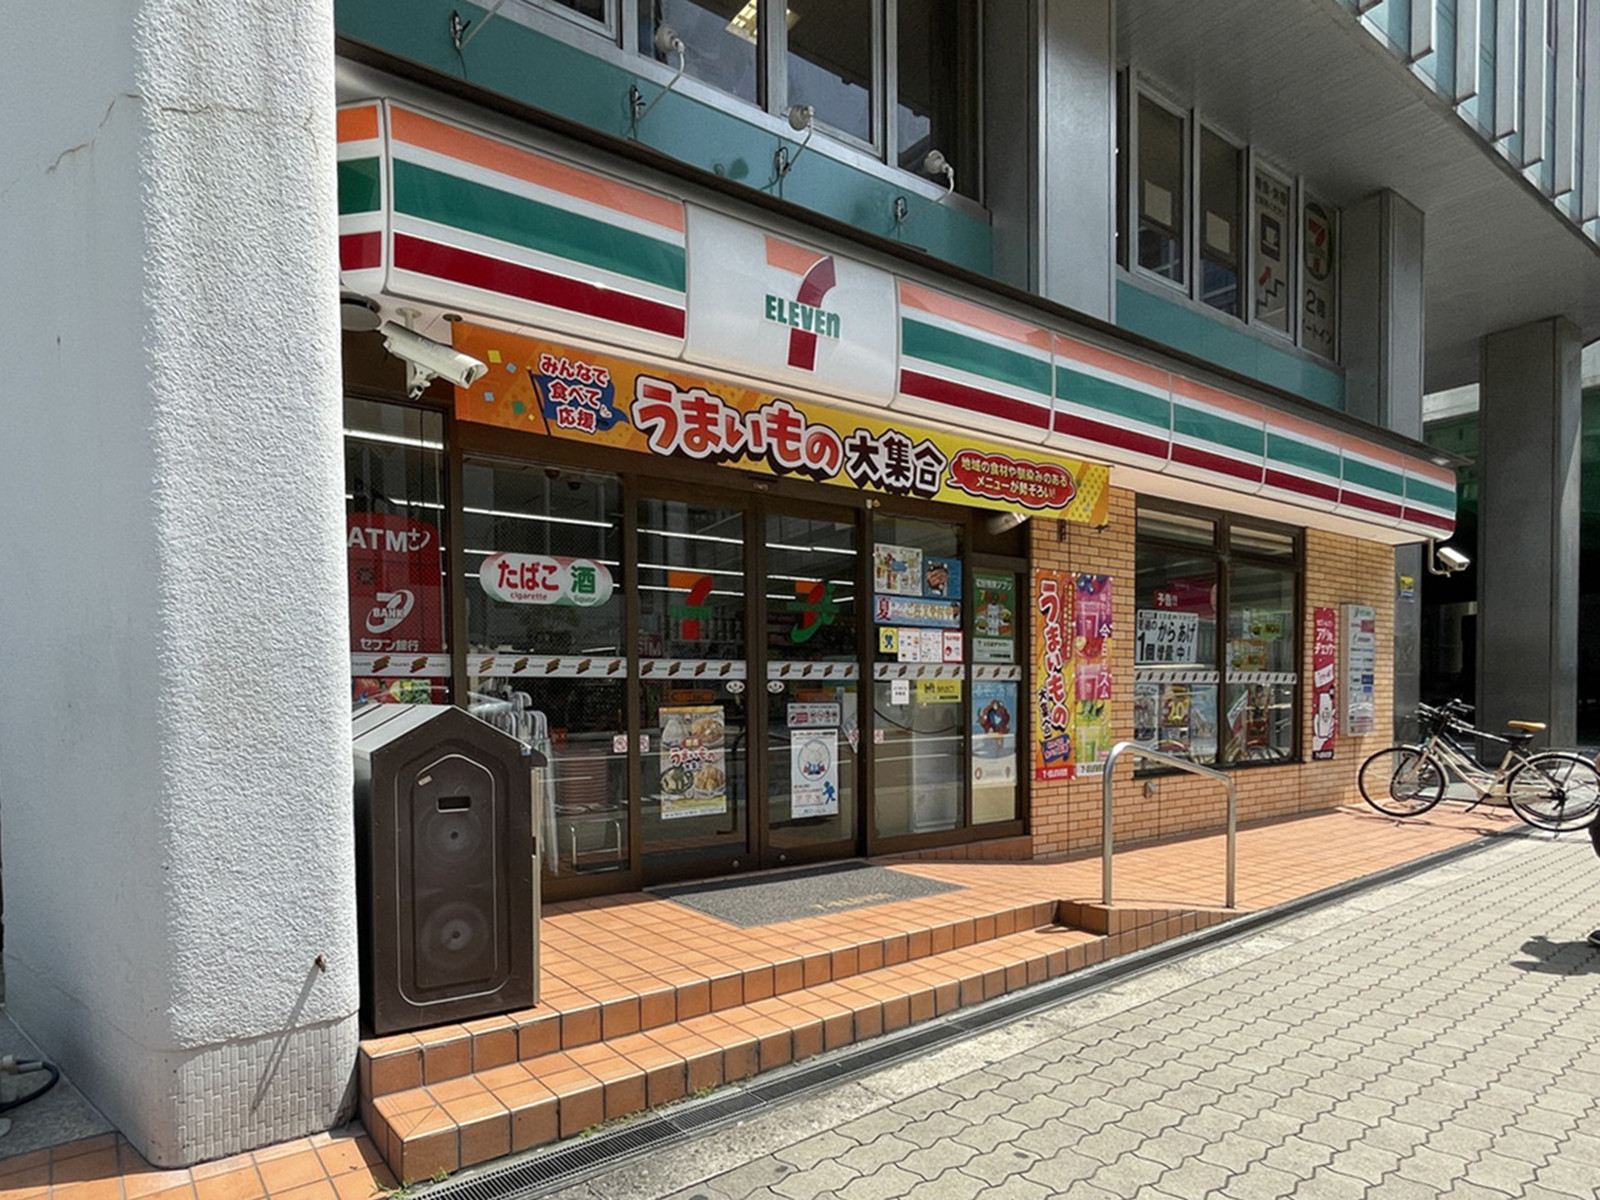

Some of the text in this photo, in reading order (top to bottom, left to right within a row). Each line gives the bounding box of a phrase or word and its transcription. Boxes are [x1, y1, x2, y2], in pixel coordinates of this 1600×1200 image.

[540, 354, 609, 387] みんなで
[548, 380, 602, 408] 食べて
[557, 406, 595, 433] 応援
[633, 378, 946, 492] うまいもの 大集合
[497, 560, 559, 591] たばこ
[570, 565, 596, 594] 酒
[510, 592, 548, 601] cigarette
[876, 597, 891, 621] 夏
[360, 637, 419, 652] セブン銀行
[1157, 621, 1196, 643] からあげ
[1040, 580, 1068, 727] うまいもの
